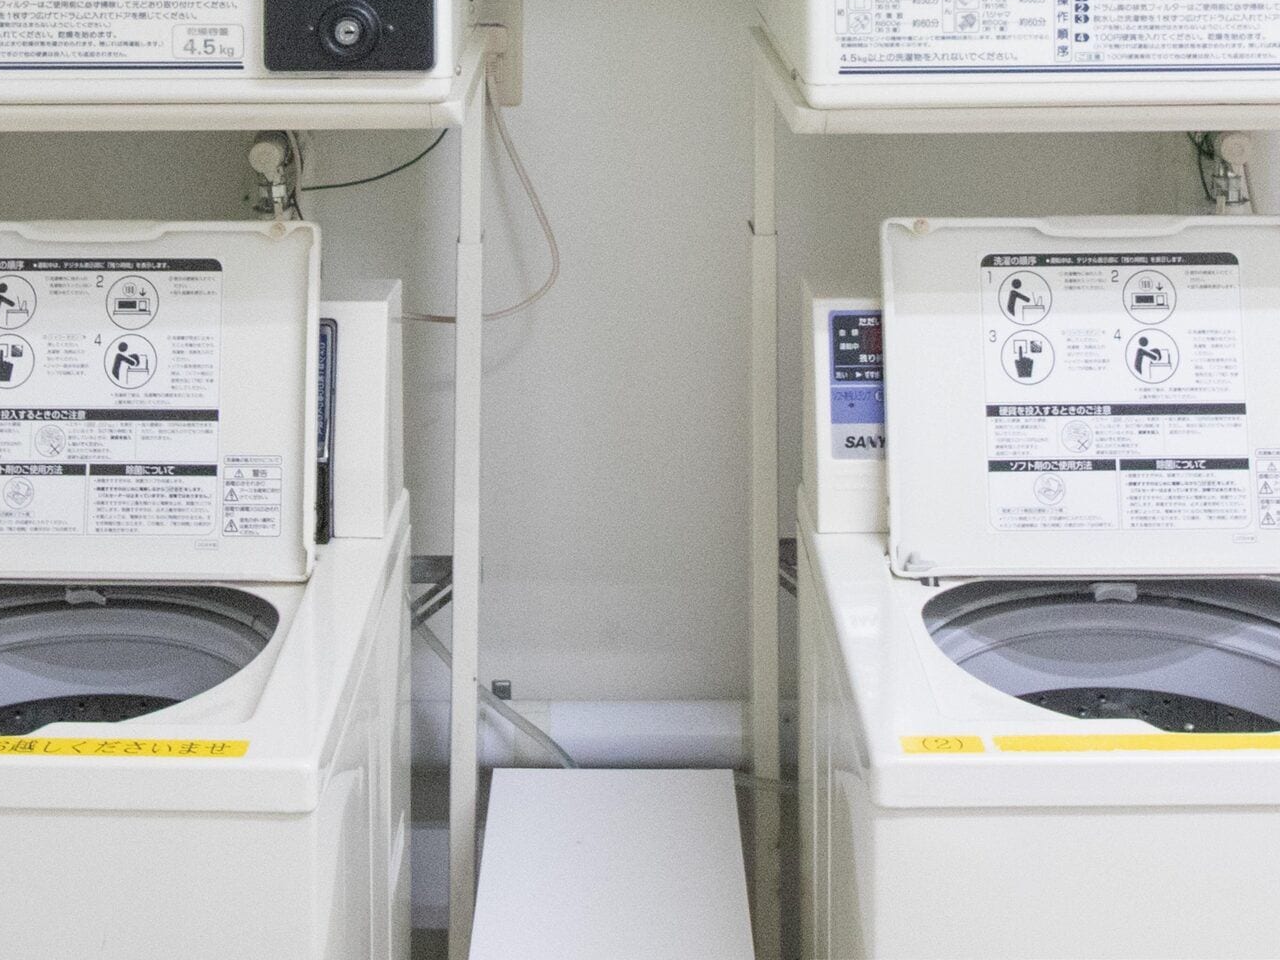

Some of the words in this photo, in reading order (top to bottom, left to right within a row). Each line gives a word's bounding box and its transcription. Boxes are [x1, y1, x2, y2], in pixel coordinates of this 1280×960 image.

[183, 38, 216, 56] 4.5
[219, 44, 235, 58] kg
[96, 275, 104, 288] 2
[986, 270, 992, 284] 1
[1111, 270, 1120, 283] 2
[94, 334, 102, 346] 4
[988, 330, 996, 342] 3
[1114, 329, 1122, 340] 4
[998, 406, 1111, 416] 硬貨を投入するときのご注意
[1010, 460, 1092, 470] ソフト剤のご使用方法
[921, 737, 964, 751] (2)
